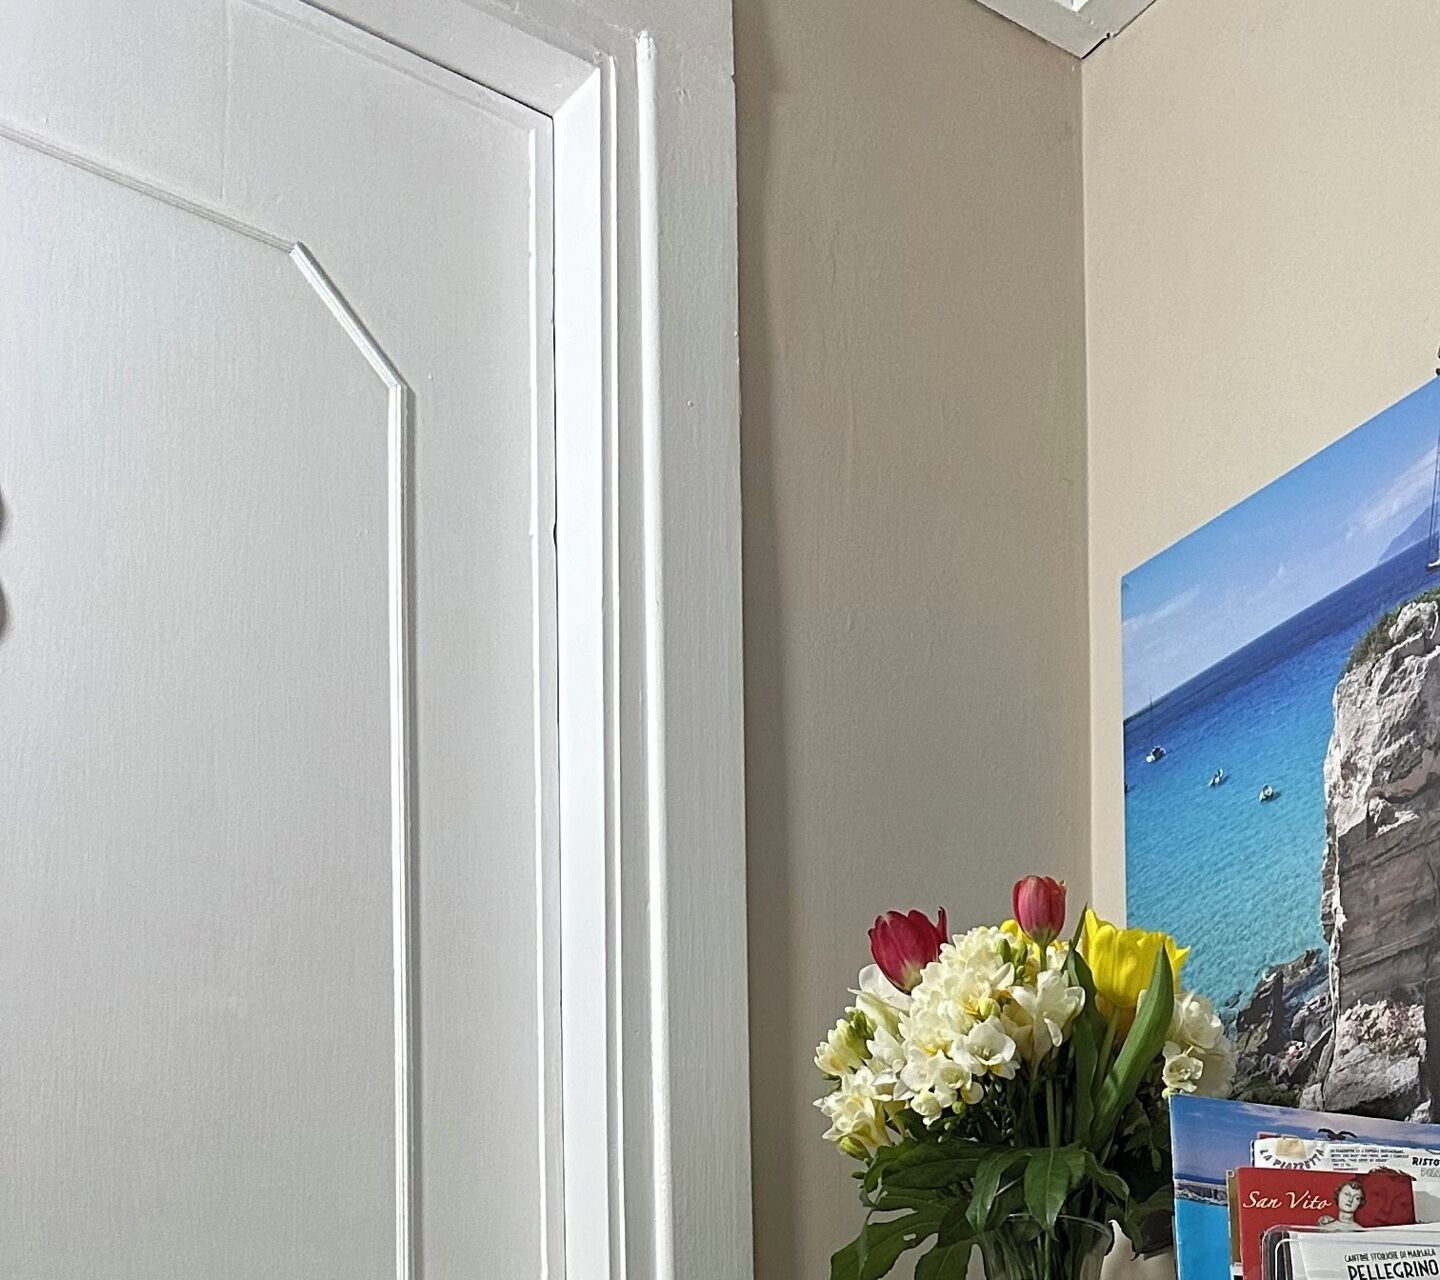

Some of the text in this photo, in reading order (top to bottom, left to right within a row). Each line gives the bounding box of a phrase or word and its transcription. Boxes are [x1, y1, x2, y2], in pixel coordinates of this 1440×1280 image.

[1259, 1148, 1273, 1162] LA
[1243, 1190, 1332, 1210] San Vito
[1344, 1253, 1369, 1263] CANTINE
[1371, 1250, 1398, 1261] STORICHE
[1407, 1248, 1436, 1259] MARSALA
[1347, 1259, 1439, 1280] PELLEGRINO
